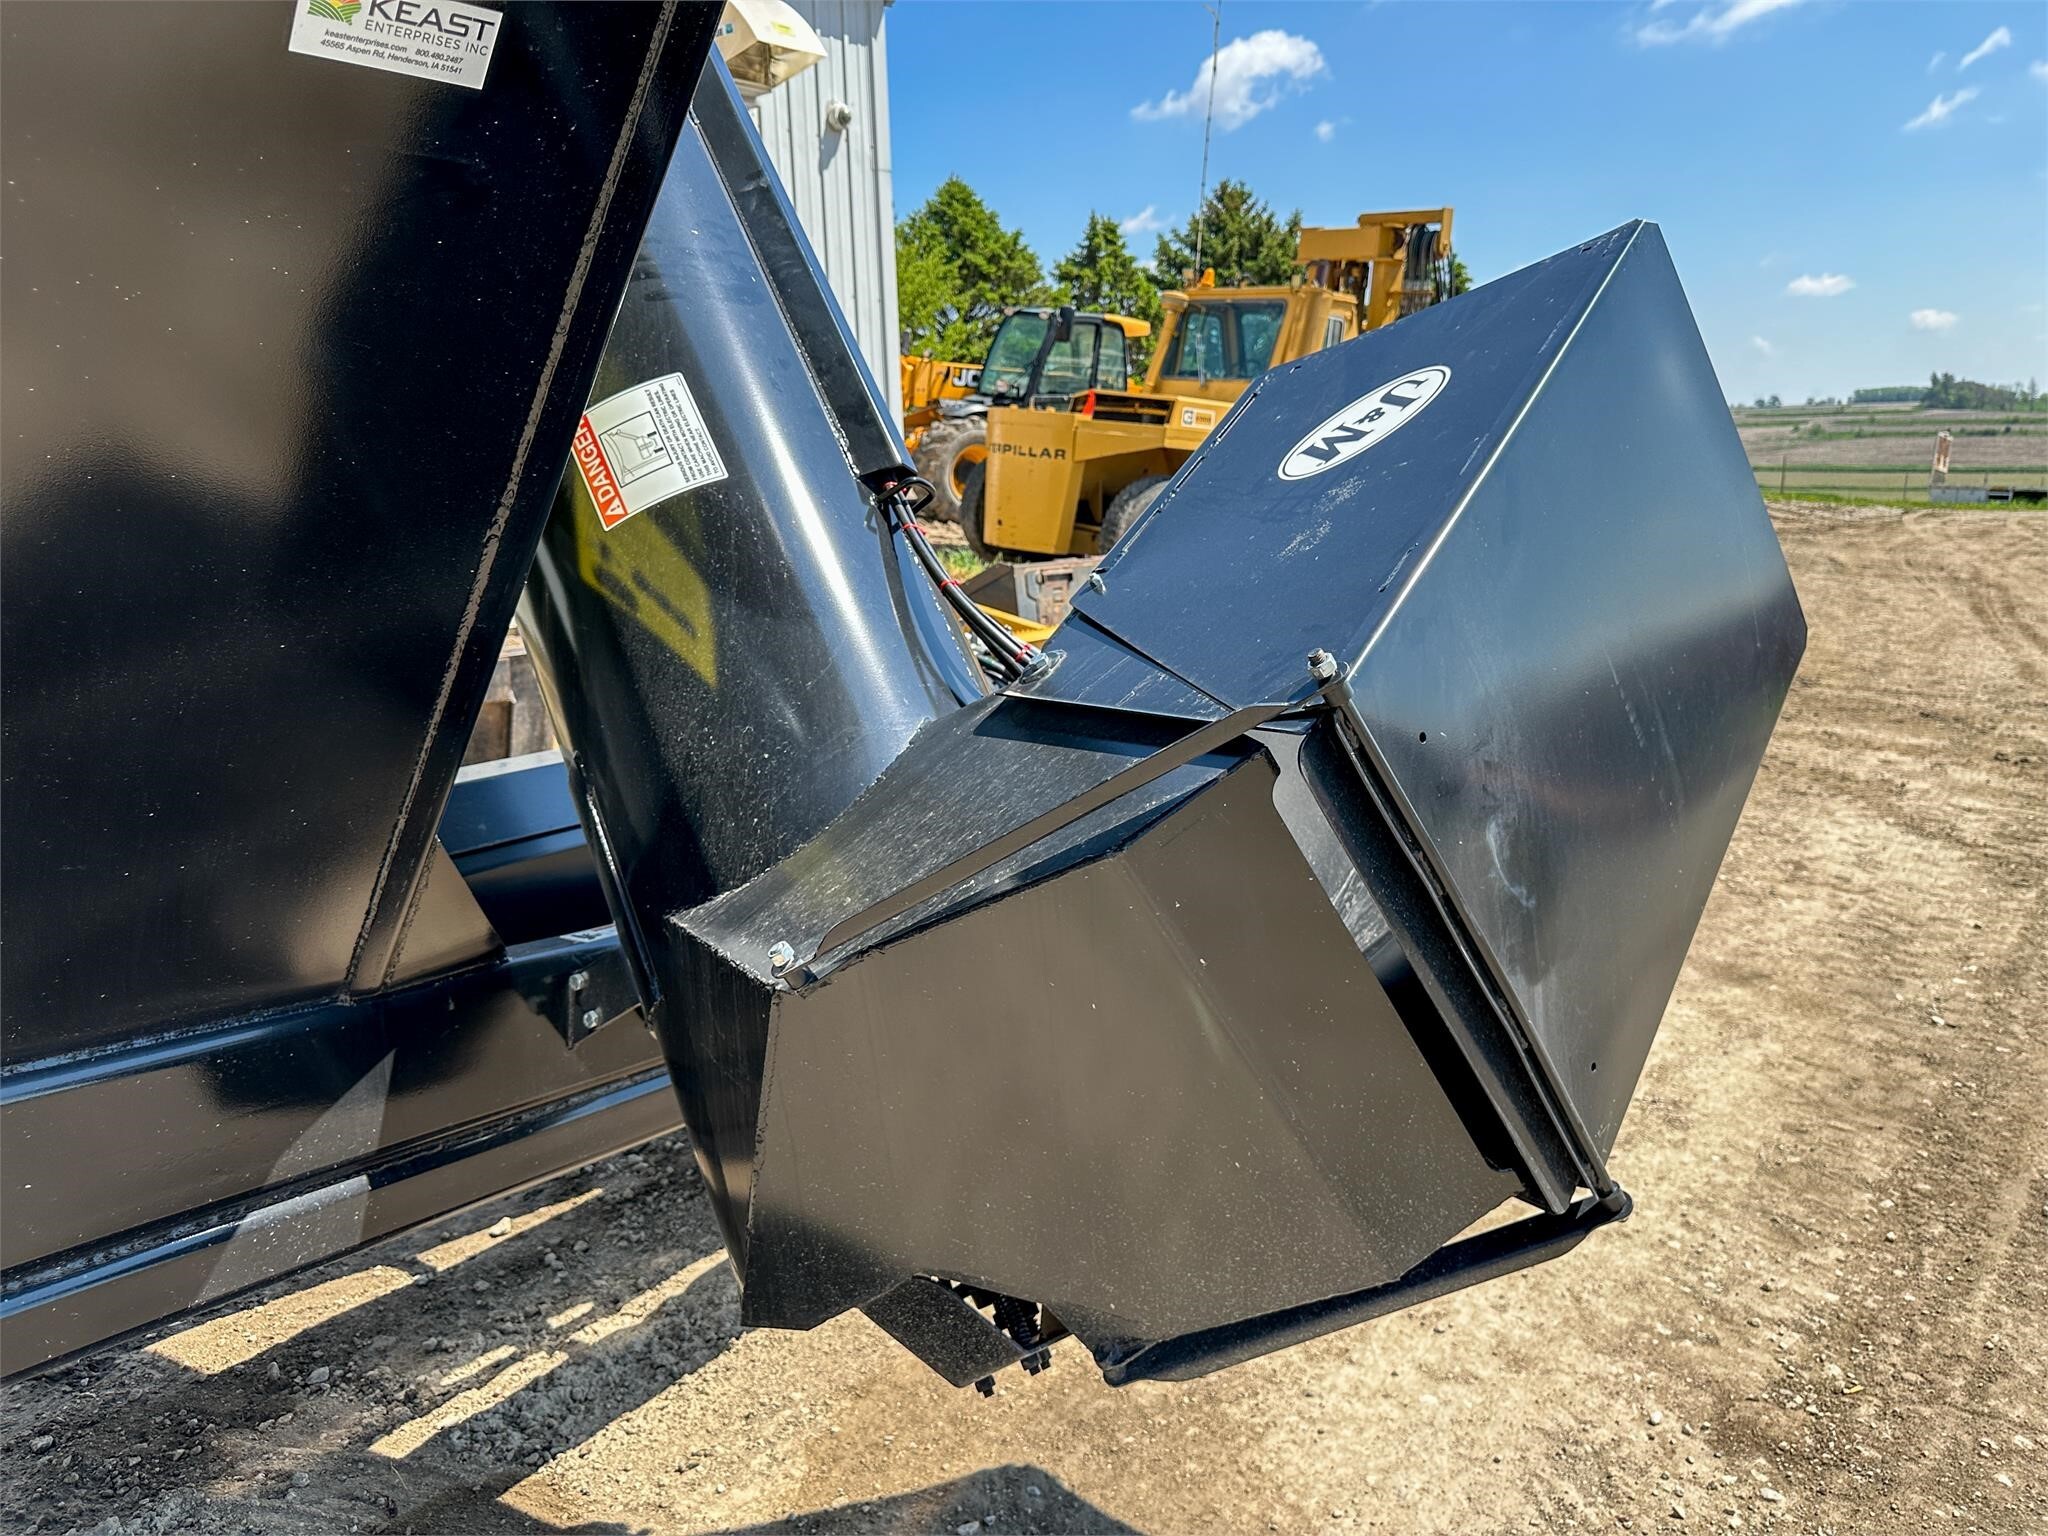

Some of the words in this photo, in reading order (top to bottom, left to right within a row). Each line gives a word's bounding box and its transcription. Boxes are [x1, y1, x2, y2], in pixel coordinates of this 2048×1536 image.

[364, 19, 462, 50] ENTERPRISES
[465, 43, 489, 56] INC
[368, 0, 496, 41] KEAST
[324, 29, 408, 53] keastenterprises.com
[415, 48, 464, 65] 800.480.2487
[345, 44, 372, 57] Aspen
[372, 50, 386, 60] Rd,
[387, 52, 430, 69] Henderson,
[430, 60, 440, 70] IA
[440, 63, 463, 75] 51541
[1297, 378, 1430, 465] J&M
